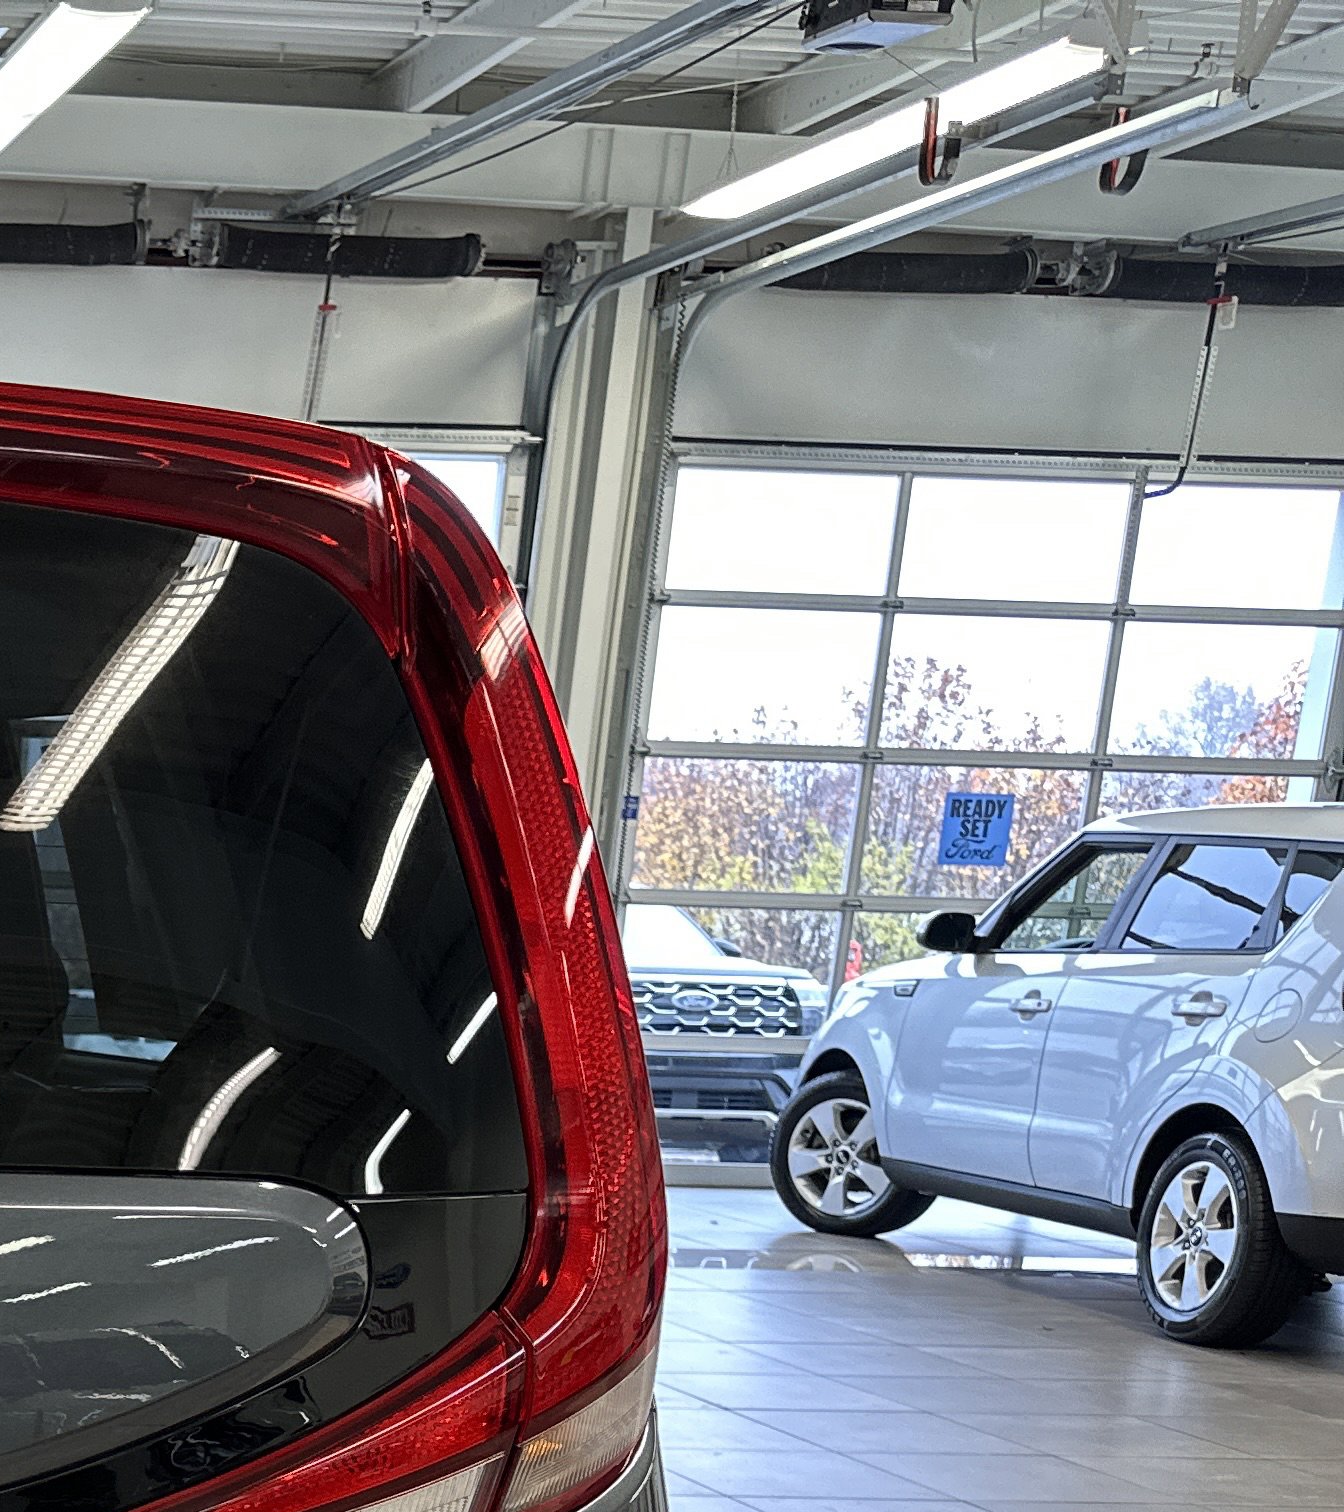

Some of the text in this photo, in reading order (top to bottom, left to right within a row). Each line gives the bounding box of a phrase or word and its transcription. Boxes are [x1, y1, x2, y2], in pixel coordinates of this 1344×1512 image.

[950, 798, 1007, 819] READY
[959, 819, 991, 838] SET
[945, 838, 1002, 860] Ford
